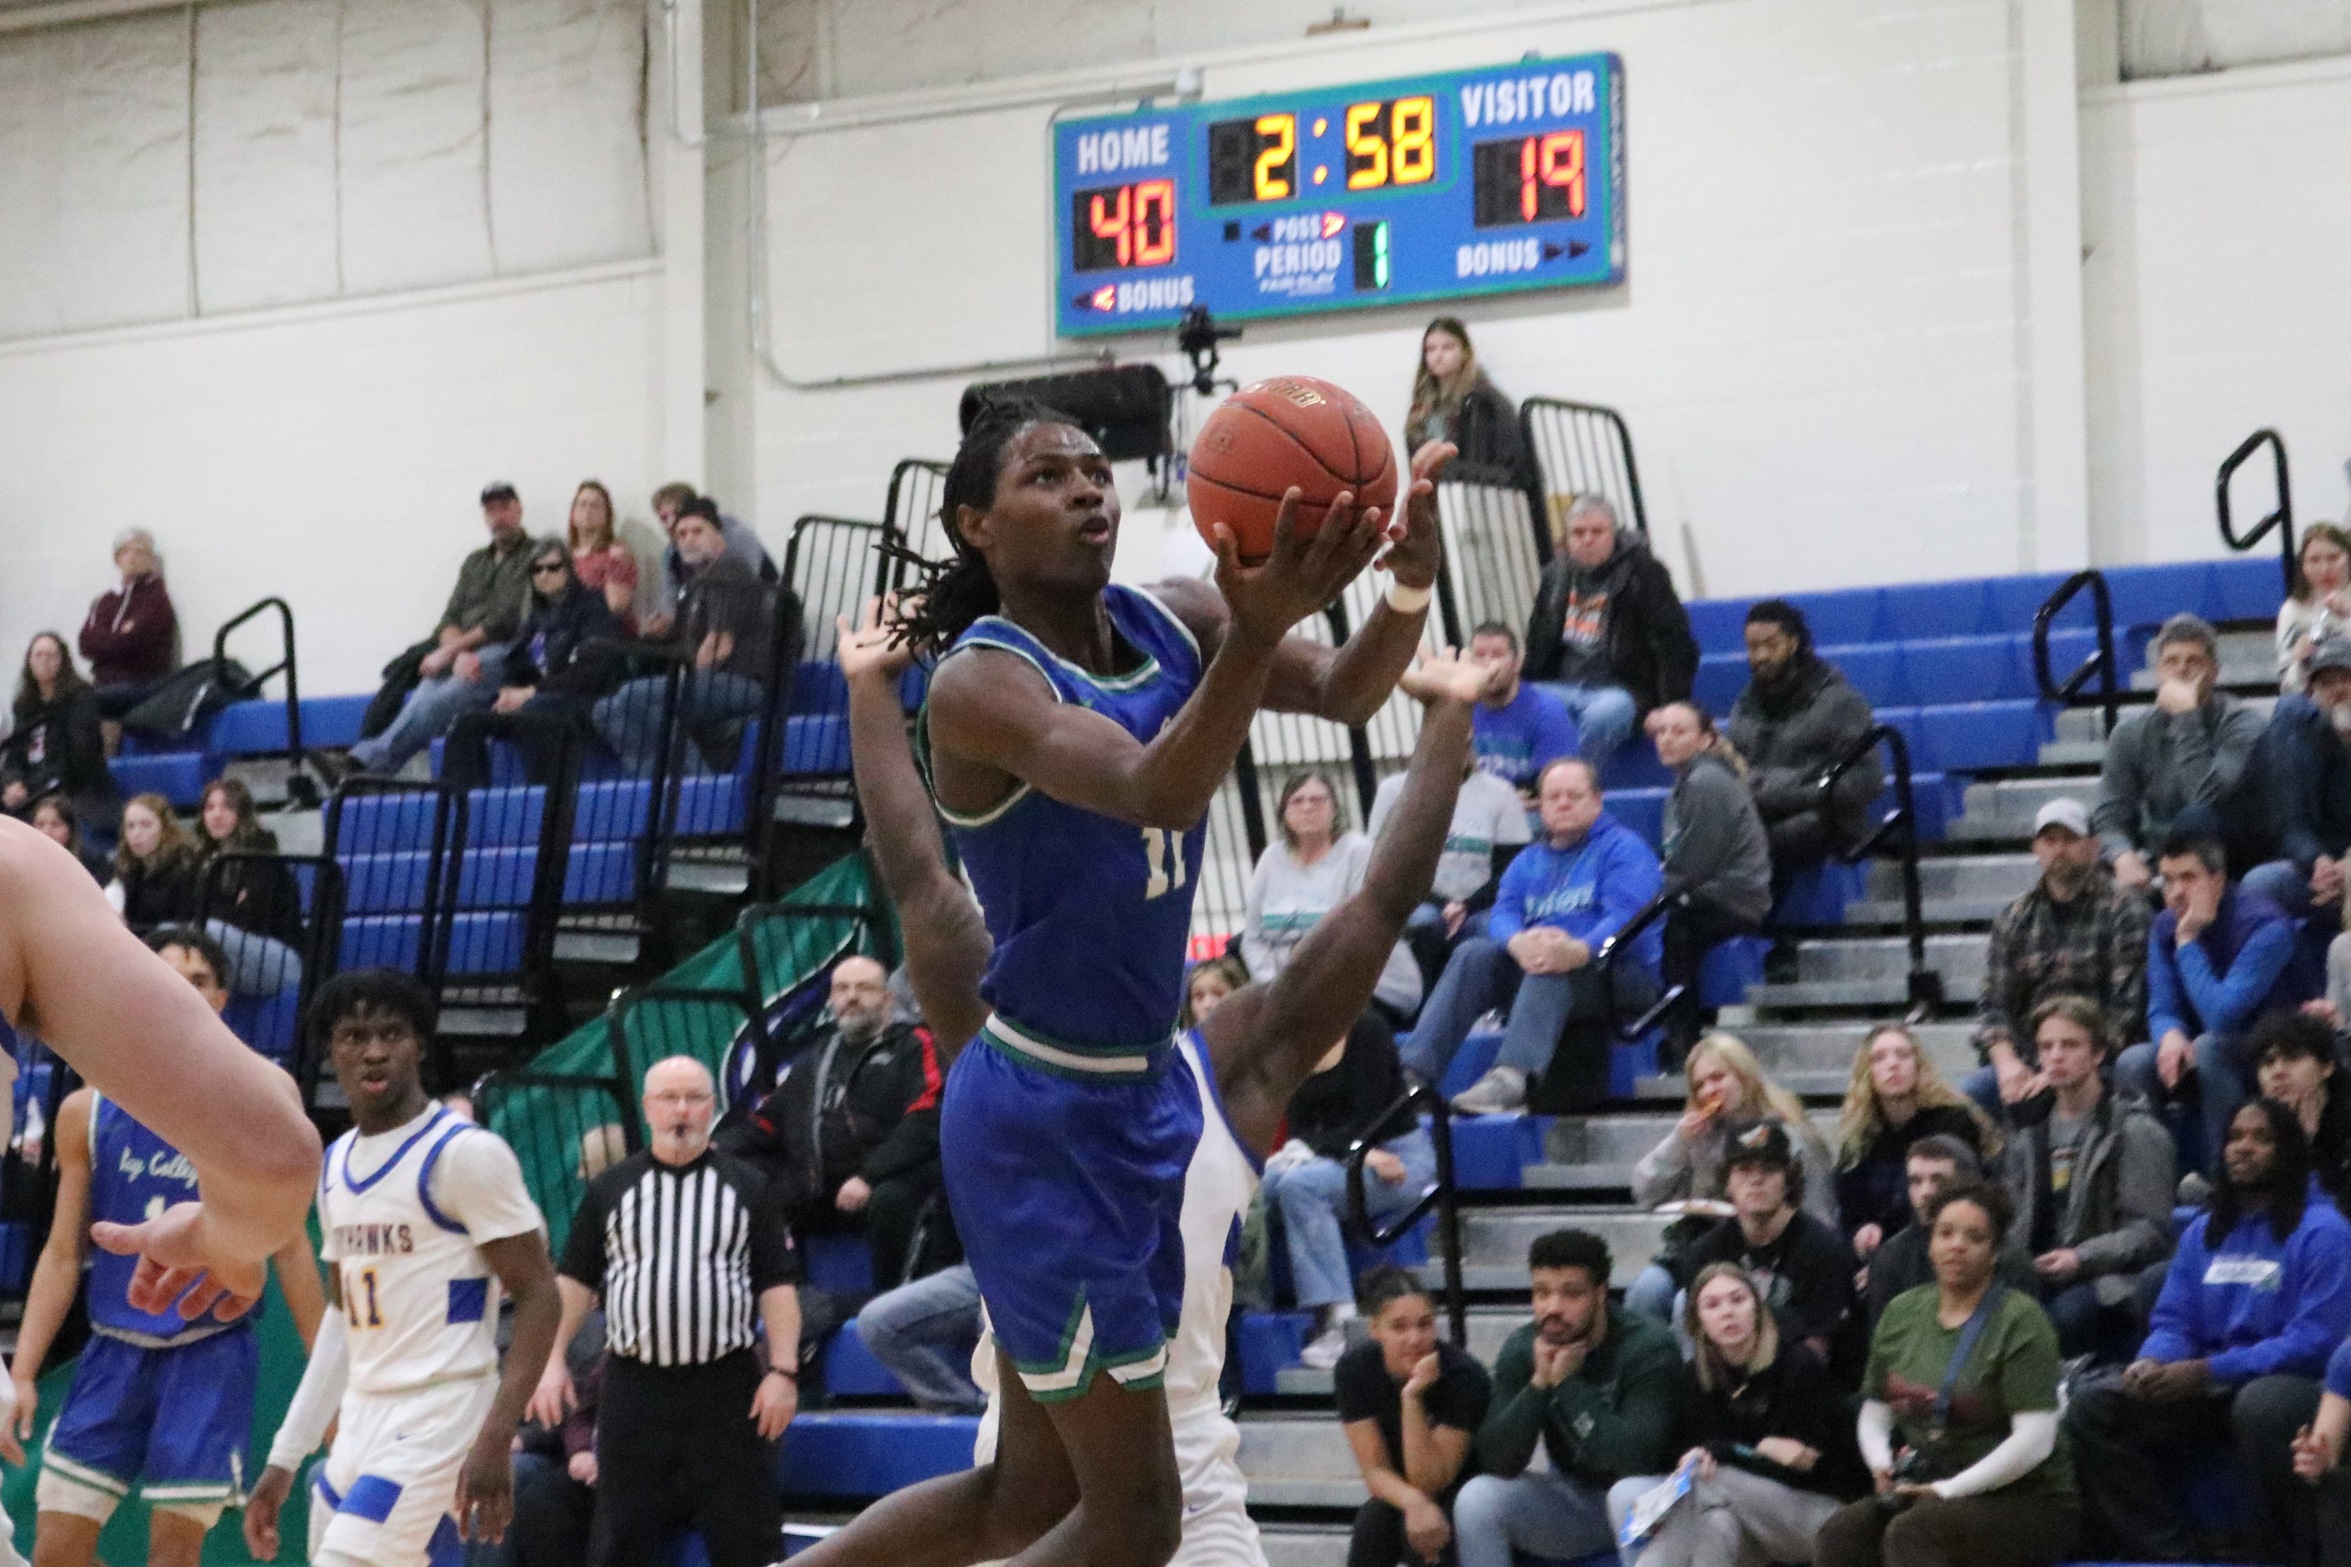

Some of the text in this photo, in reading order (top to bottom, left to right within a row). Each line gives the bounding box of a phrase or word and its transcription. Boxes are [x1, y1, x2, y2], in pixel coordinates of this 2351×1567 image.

[1461, 70, 1595, 127] VISITOR
[1078, 124, 1169, 174] HOME
[1254, 96, 1434, 201] 2:58
[1520, 130, 1585, 223] 19
[1090, 178, 1175, 267] 40
[1255, 239, 1342, 279] PERIOD
[1374, 220, 1389, 289] 1
[1457, 237, 1540, 278] BONUS
[1118, 275, 1194, 313] BONUS
